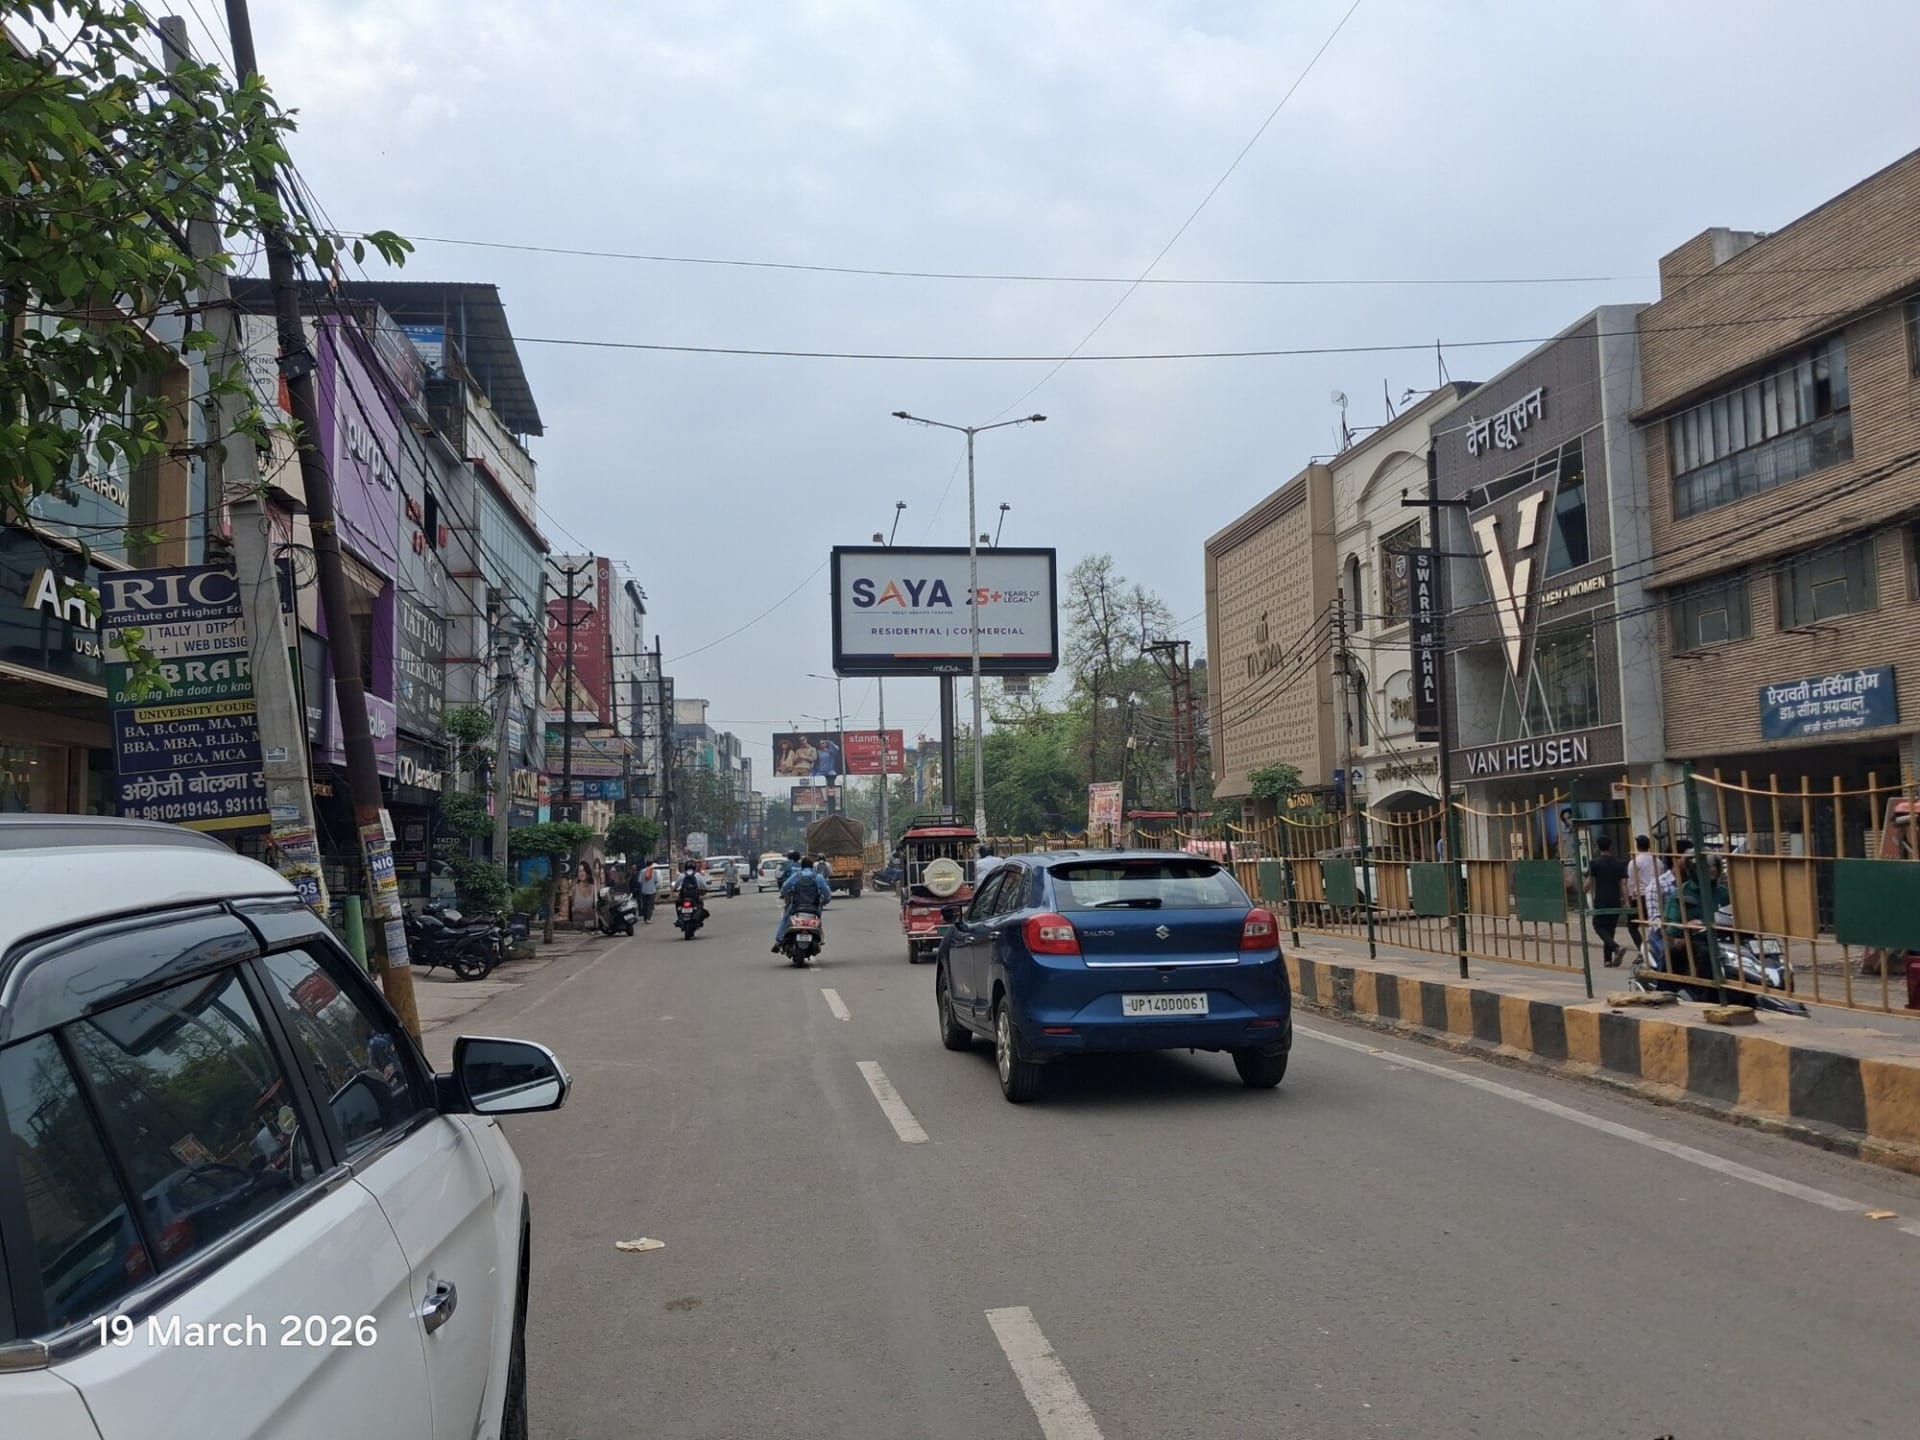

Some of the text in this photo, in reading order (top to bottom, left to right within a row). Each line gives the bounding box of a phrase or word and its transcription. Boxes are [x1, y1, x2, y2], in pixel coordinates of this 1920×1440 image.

[80, 470, 130, 509] ARROW
[852, 578, 953, 608] SAYA
[1416, 555, 1431, 624] SWARN
[1541, 575, 1606, 608] MEN WOMEN
[108, 612, 162, 624] Institute
[165, 608, 178, 619] of
[182, 606, 224, 621] Higher
[402, 600, 443, 652] TATTOO
[158, 625, 191, 638] TALLY
[206, 622, 228, 634] DTP
[871, 628, 943, 636] RESIDENTIAL
[184, 640, 210, 652] WEB
[214, 636, 248, 649] DESIG
[400, 647, 442, 690] PIERCING
[1420, 632, 1435, 703] MAHAL
[187, 684, 213, 696] door
[216, 681, 229, 693] to
[1767, 681, 1810, 705] ऐरावती
[1854, 671, 1880, 694] होम
[138, 702, 257, 721] UNIVERSITY COURS
[1797, 700, 1820, 718] सीमा
[1822, 695, 1865, 714] अग्रवाल
[212, 748, 247, 762] MCA
[1466, 749, 1500, 775] VAN
[1505, 736, 1588, 771] HEUSEN
[122, 771, 183, 802] अंग्रेजी
[188, 771, 249, 793] बोलना
[225, 796, 270, 813] 931111
[371, 855, 394, 872] NIO
[1131, 997, 1205, 1012] UP14DD0061
